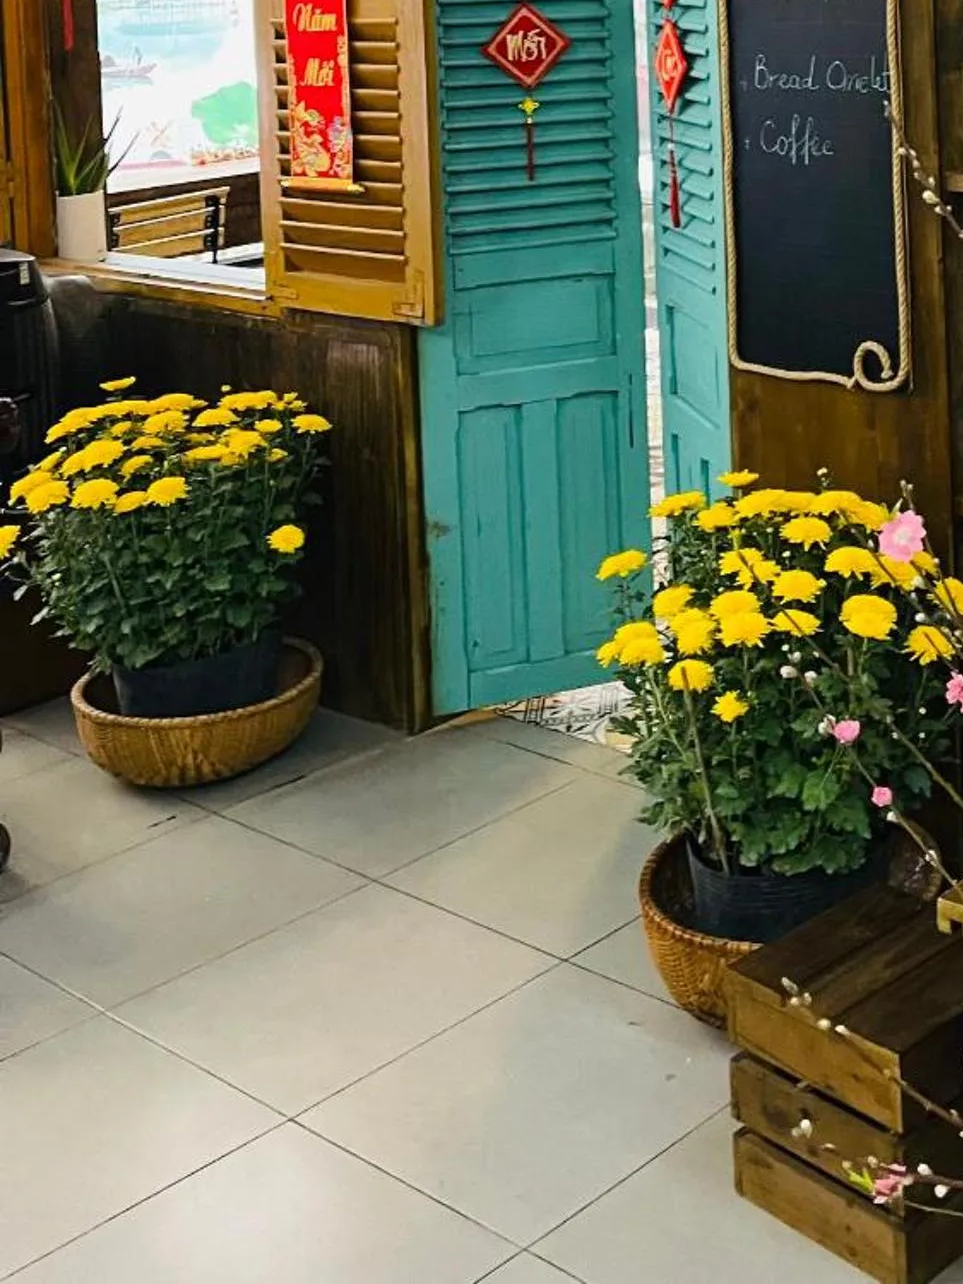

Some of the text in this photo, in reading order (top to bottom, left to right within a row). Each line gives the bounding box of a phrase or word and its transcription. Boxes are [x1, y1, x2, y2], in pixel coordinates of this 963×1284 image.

[292, 2, 338, 33] Năm
[299, 57, 335, 87] Mới
[754, 53, 820, 91] Bread
[760, 113, 835, 165] Coffee
